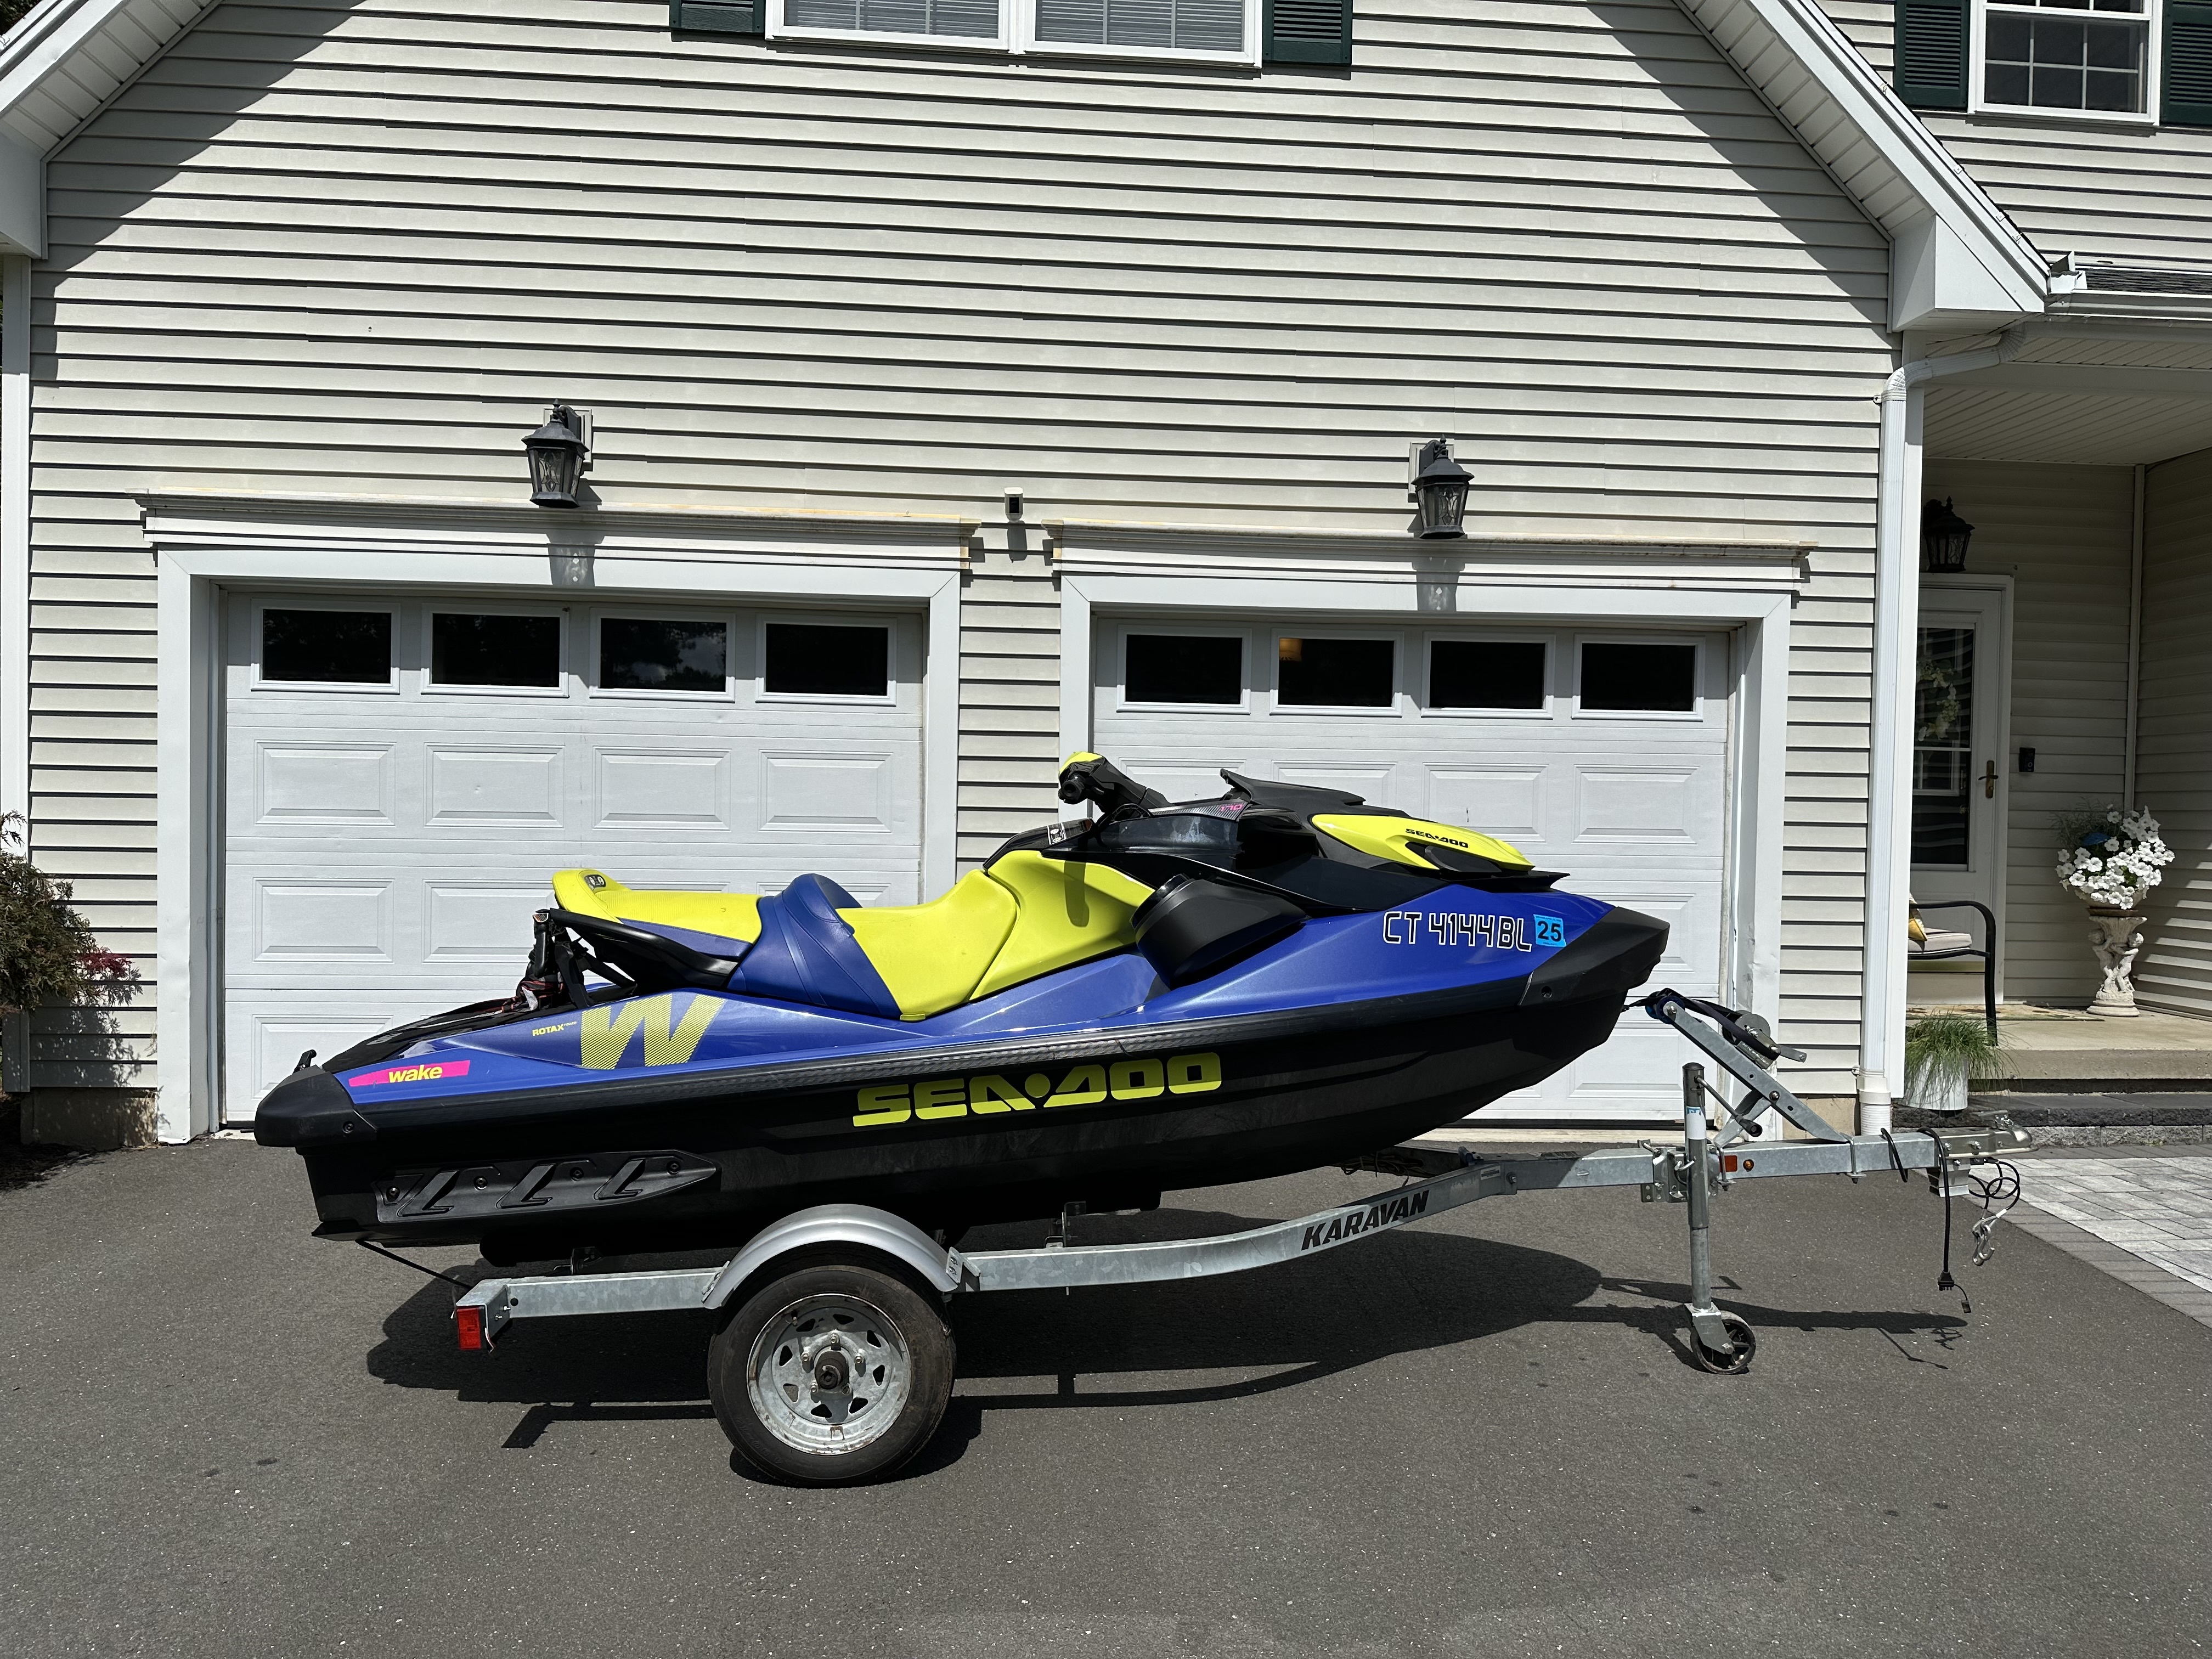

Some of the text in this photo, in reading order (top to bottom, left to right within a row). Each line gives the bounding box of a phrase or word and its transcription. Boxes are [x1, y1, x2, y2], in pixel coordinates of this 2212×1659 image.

[1221, 804, 1243, 812] 170
[1383, 911, 1422, 944] CT
[1537, 920, 1562, 943] 25
[532, 1024, 564, 1036] ROTAX
[389, 1064, 443, 1083] wake
[1301, 1190, 1429, 1251] KARAVAN
